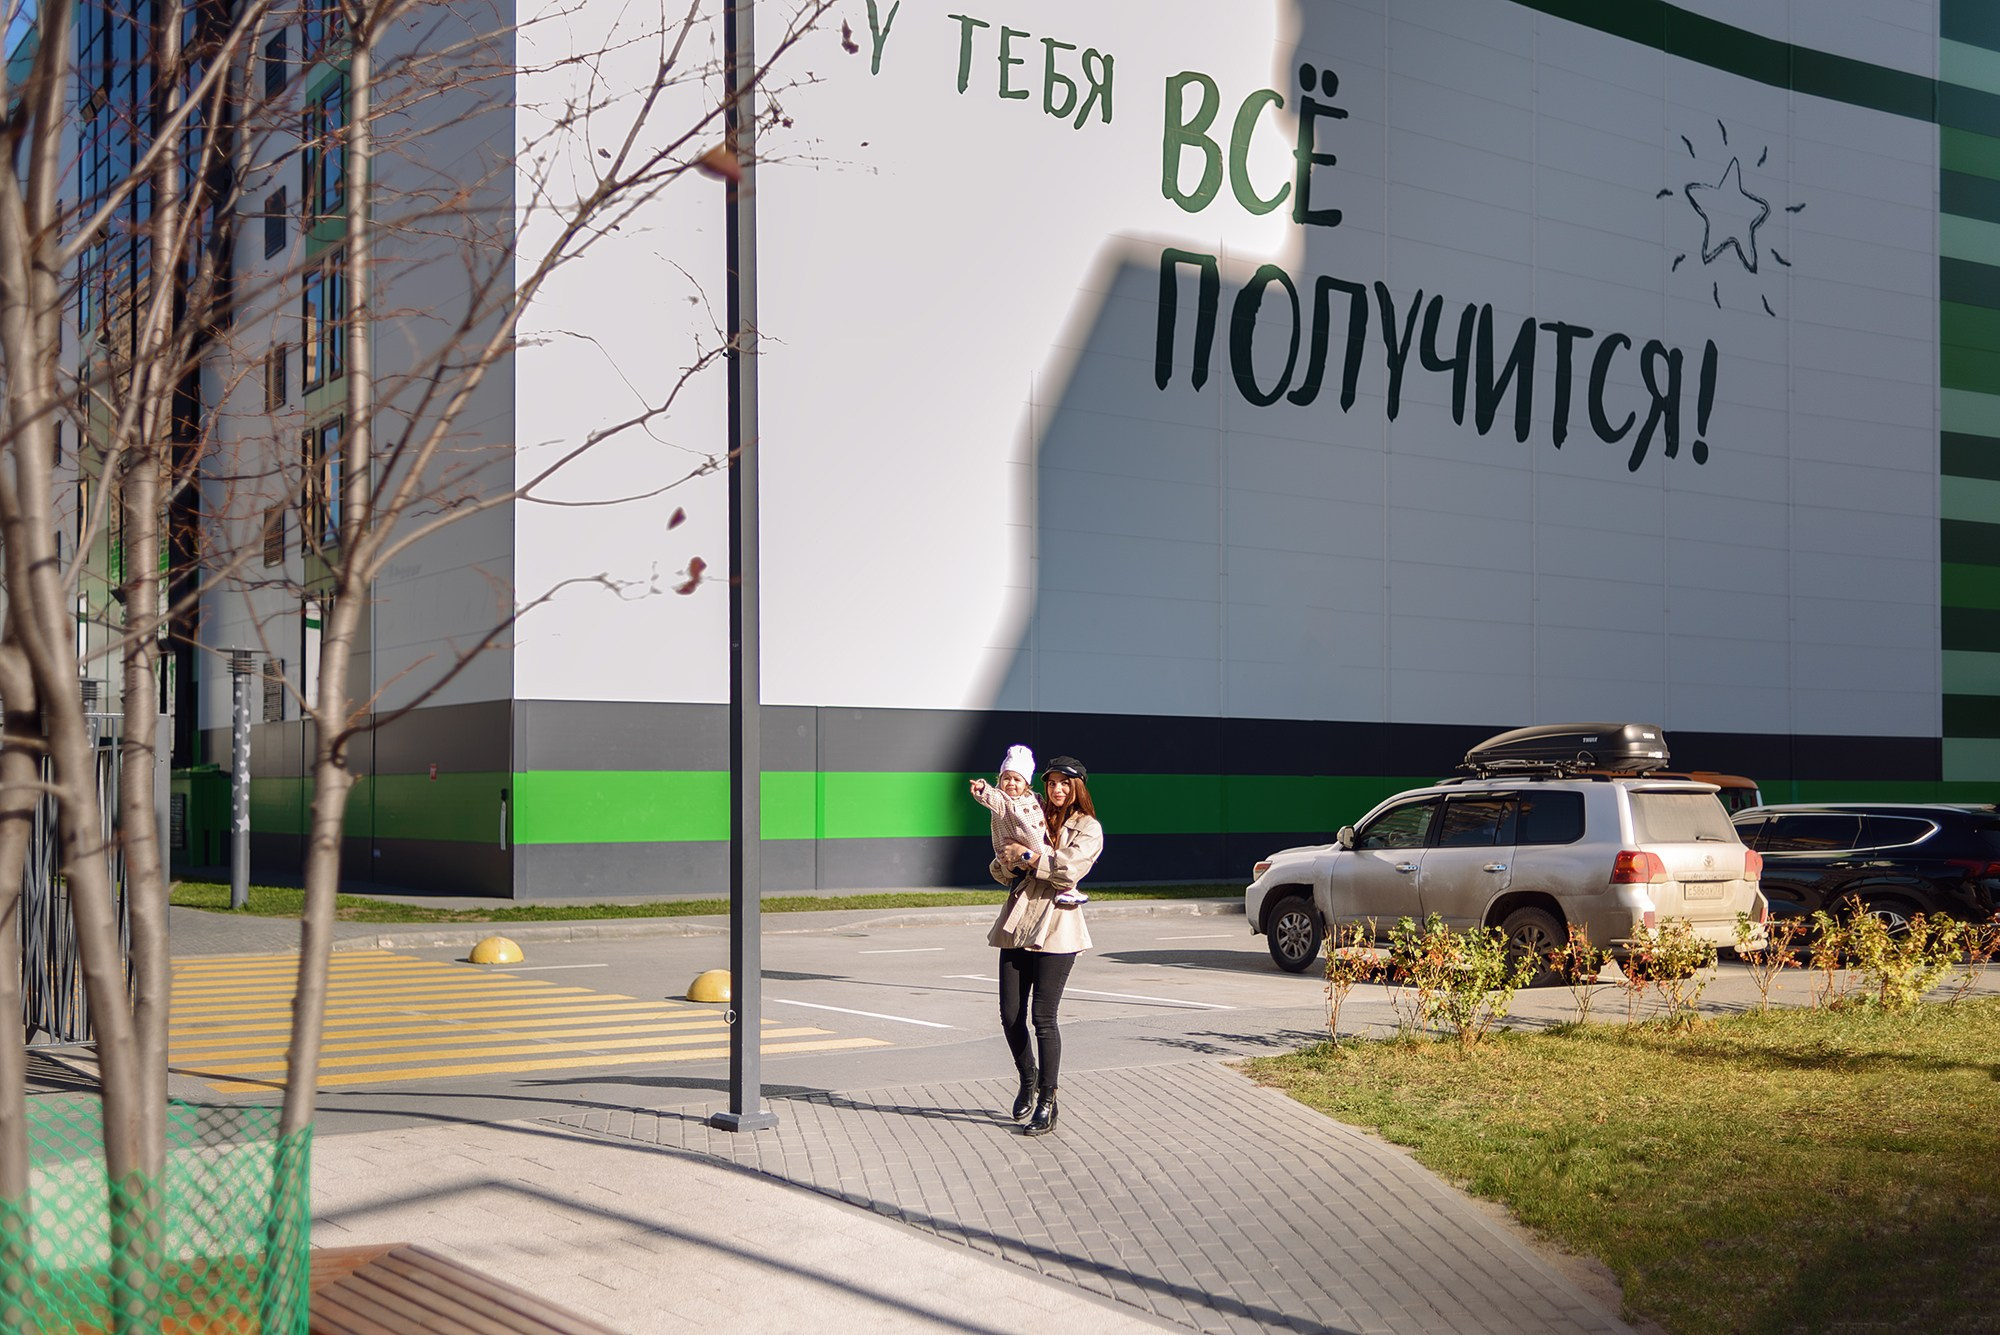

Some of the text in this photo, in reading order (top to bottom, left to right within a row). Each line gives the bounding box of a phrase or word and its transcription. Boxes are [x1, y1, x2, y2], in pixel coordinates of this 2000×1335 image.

[866, 0, 1348, 227] У ТЕБЯ ВСЁ
[1155, 248, 1718, 472] ПОЛУЧИТСЯ!
